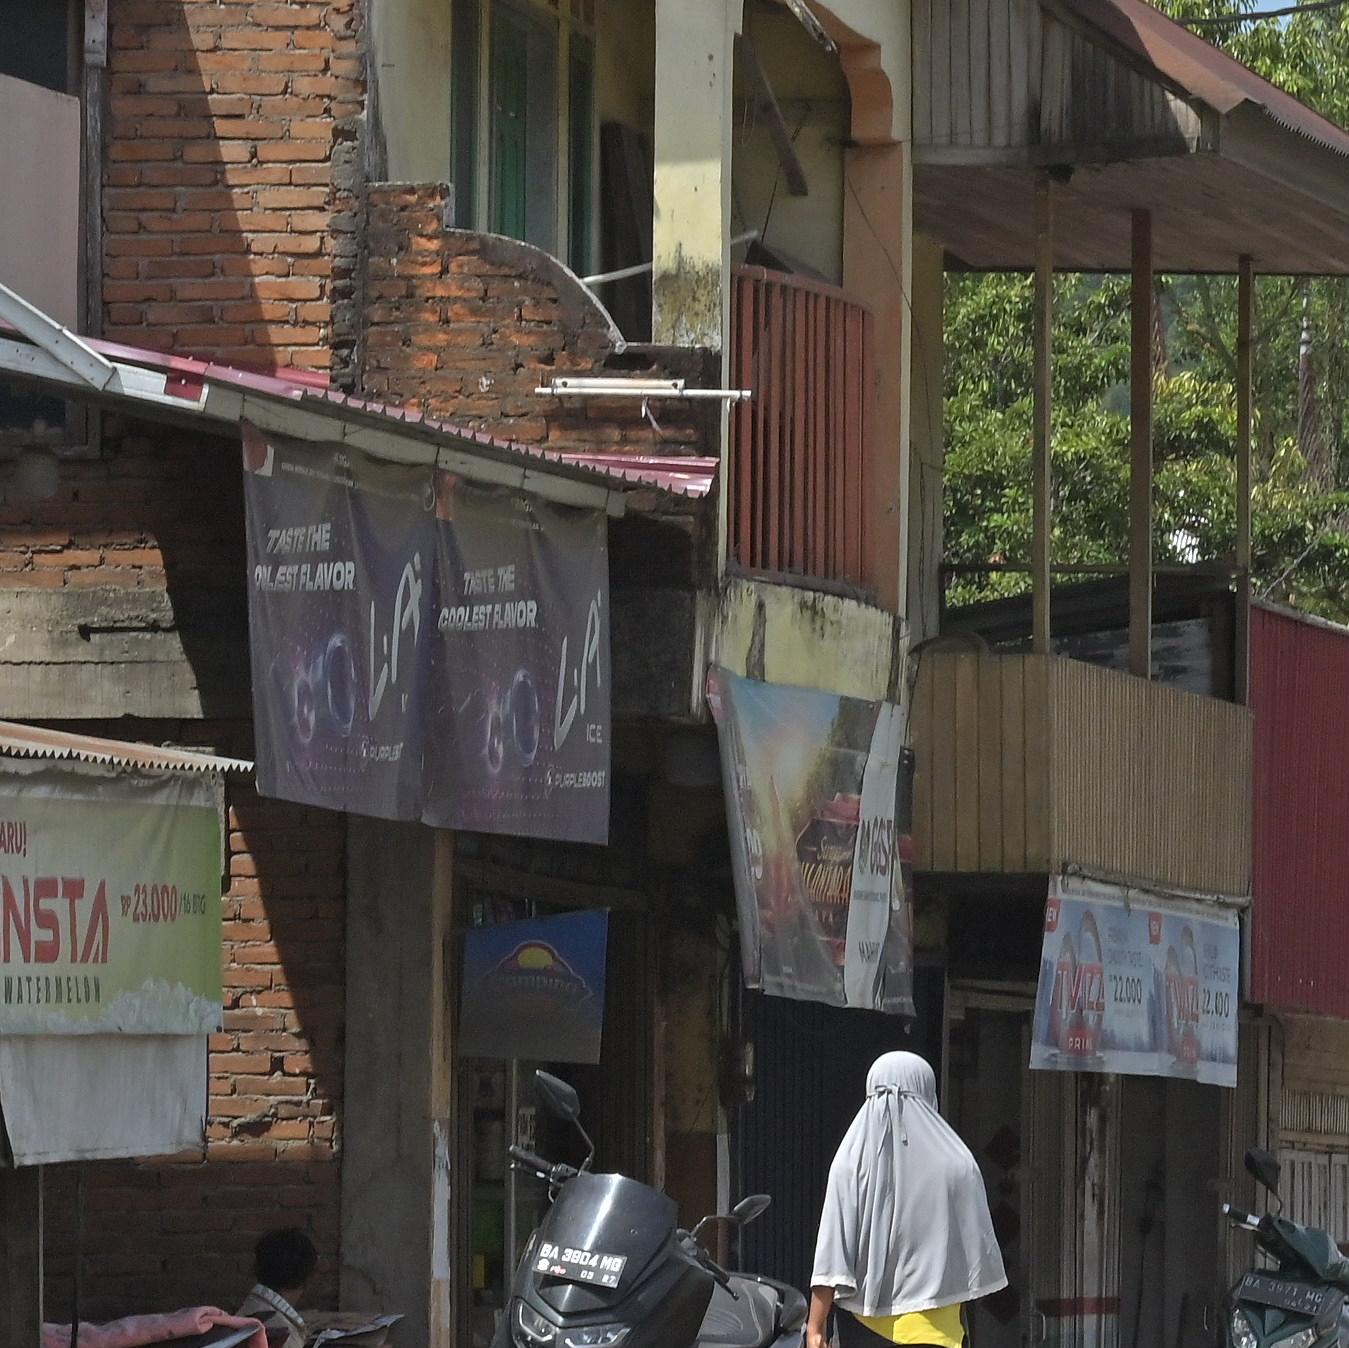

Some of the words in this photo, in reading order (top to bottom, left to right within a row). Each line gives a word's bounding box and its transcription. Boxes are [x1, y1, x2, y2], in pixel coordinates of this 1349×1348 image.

[438, 604, 492, 631] COOLEST
[133, 883, 178, 923] 23.000
[1, 874, 110, 965] NSTA
[1113, 975, 1143, 1005] 22.000
[540, 1243, 560, 1260] BA
